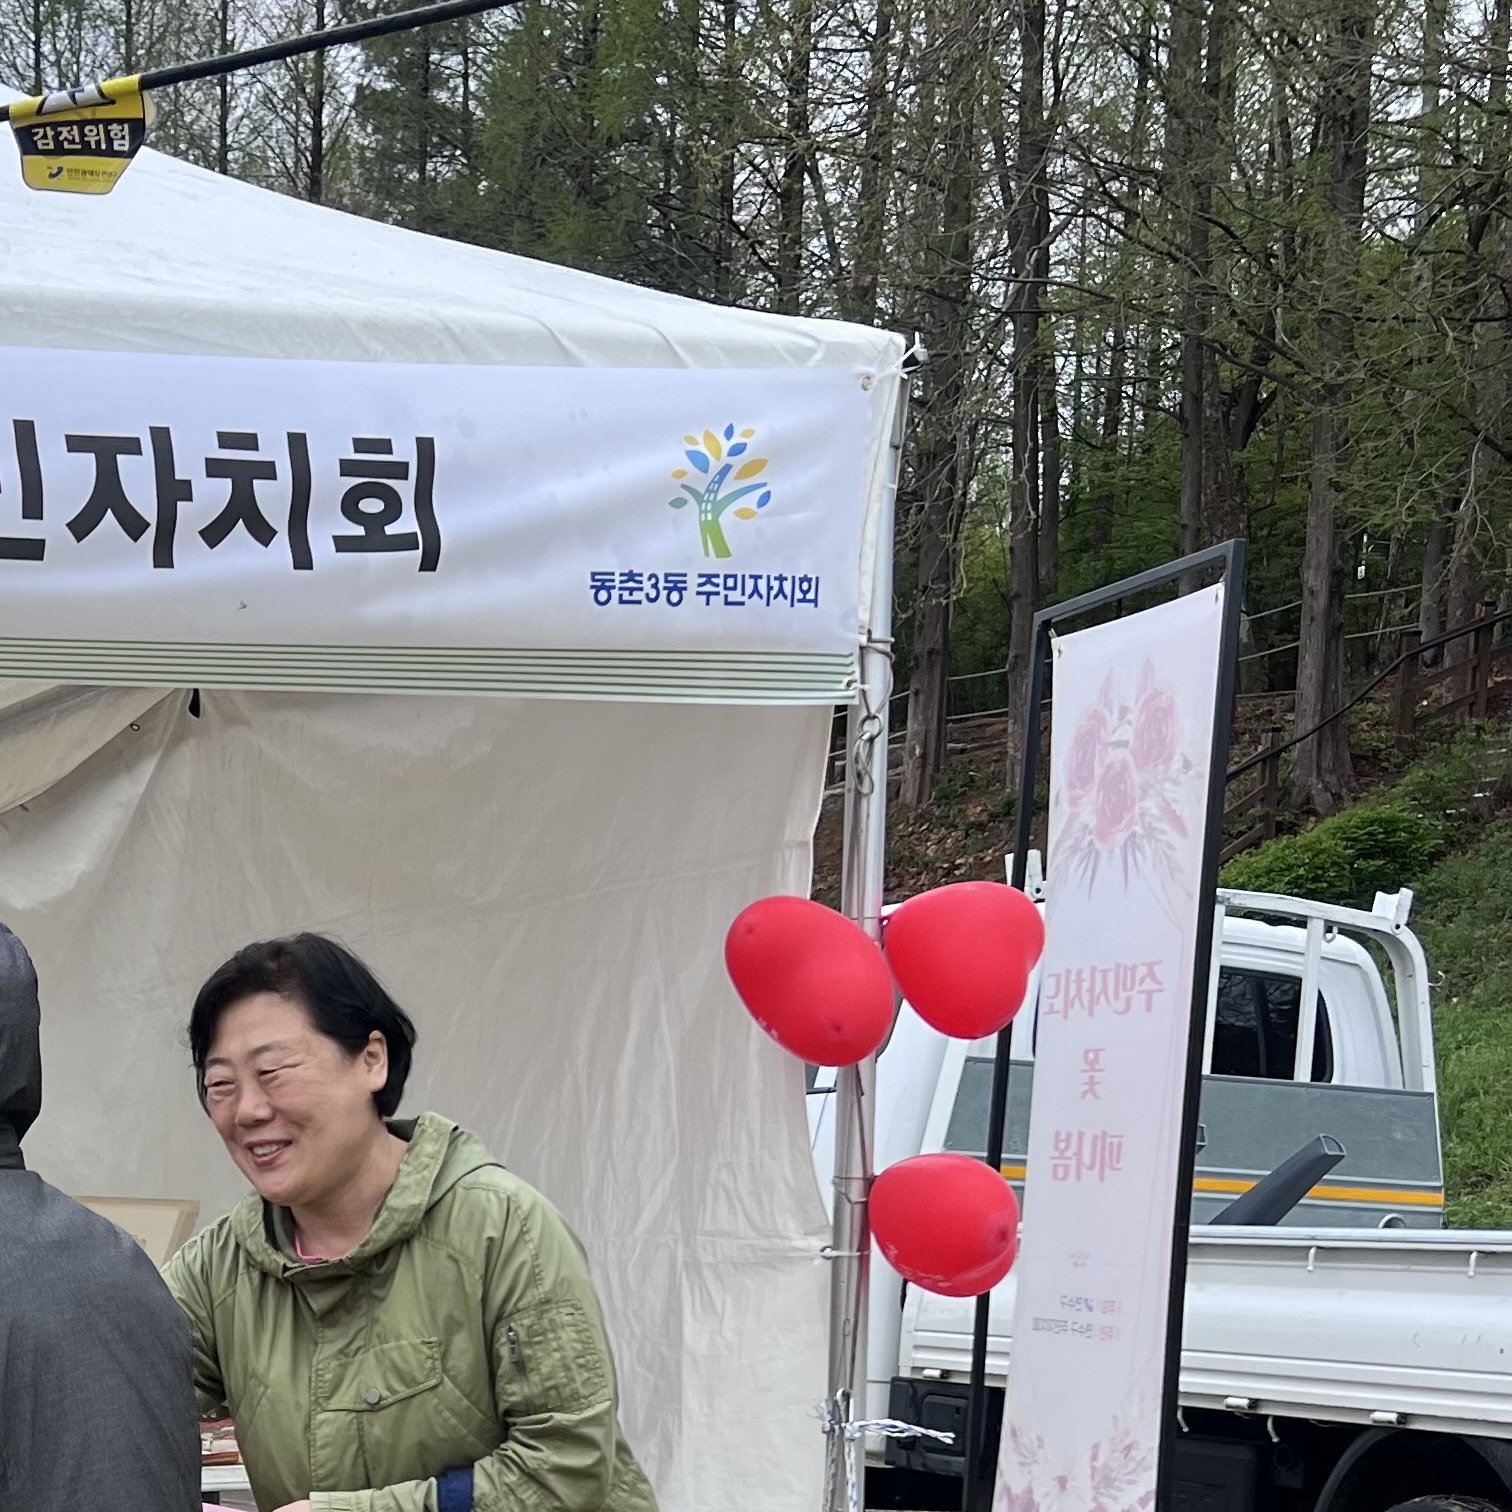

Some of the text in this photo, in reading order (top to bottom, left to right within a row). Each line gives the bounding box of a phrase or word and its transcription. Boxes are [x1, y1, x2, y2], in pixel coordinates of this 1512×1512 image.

[31, 123, 130, 151] 감전위험
[589, 570, 820, 608] 동춘3동 주민자치회
